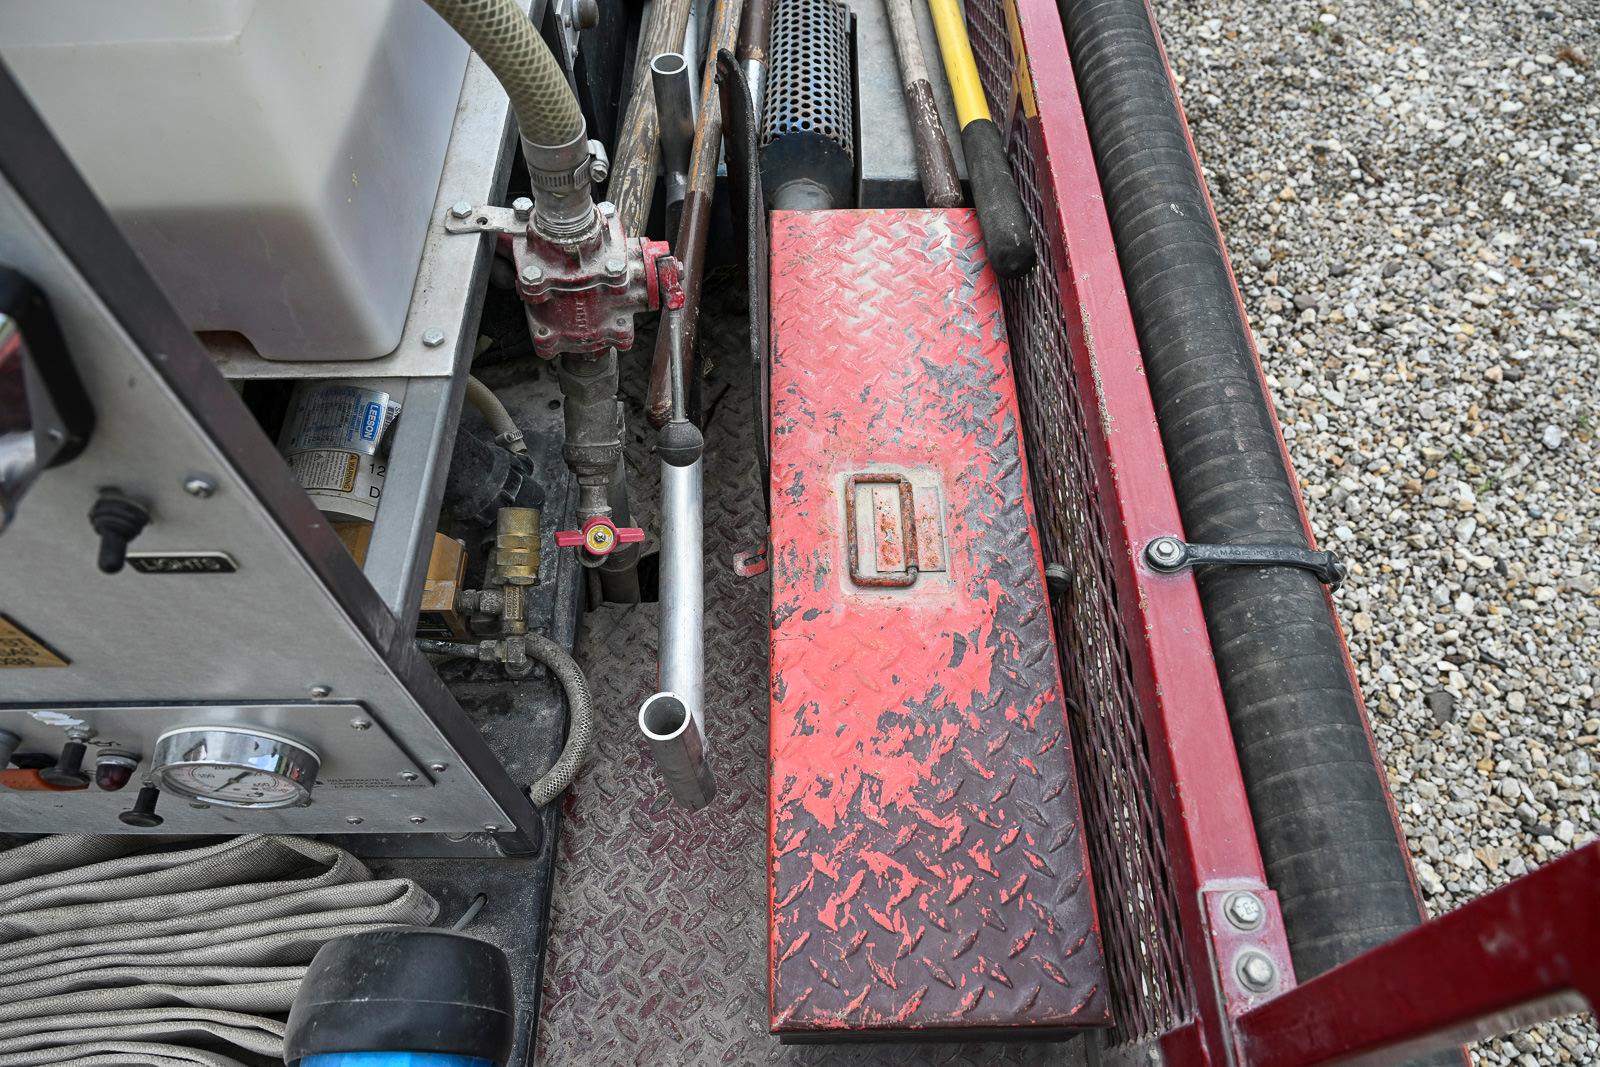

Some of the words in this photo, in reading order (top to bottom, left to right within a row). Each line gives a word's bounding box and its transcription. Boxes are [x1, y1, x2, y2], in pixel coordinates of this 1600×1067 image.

[364, 405, 379, 439] LEESON
[343, 461, 357, 490] WARNING
[369, 463, 386, 477] 12
